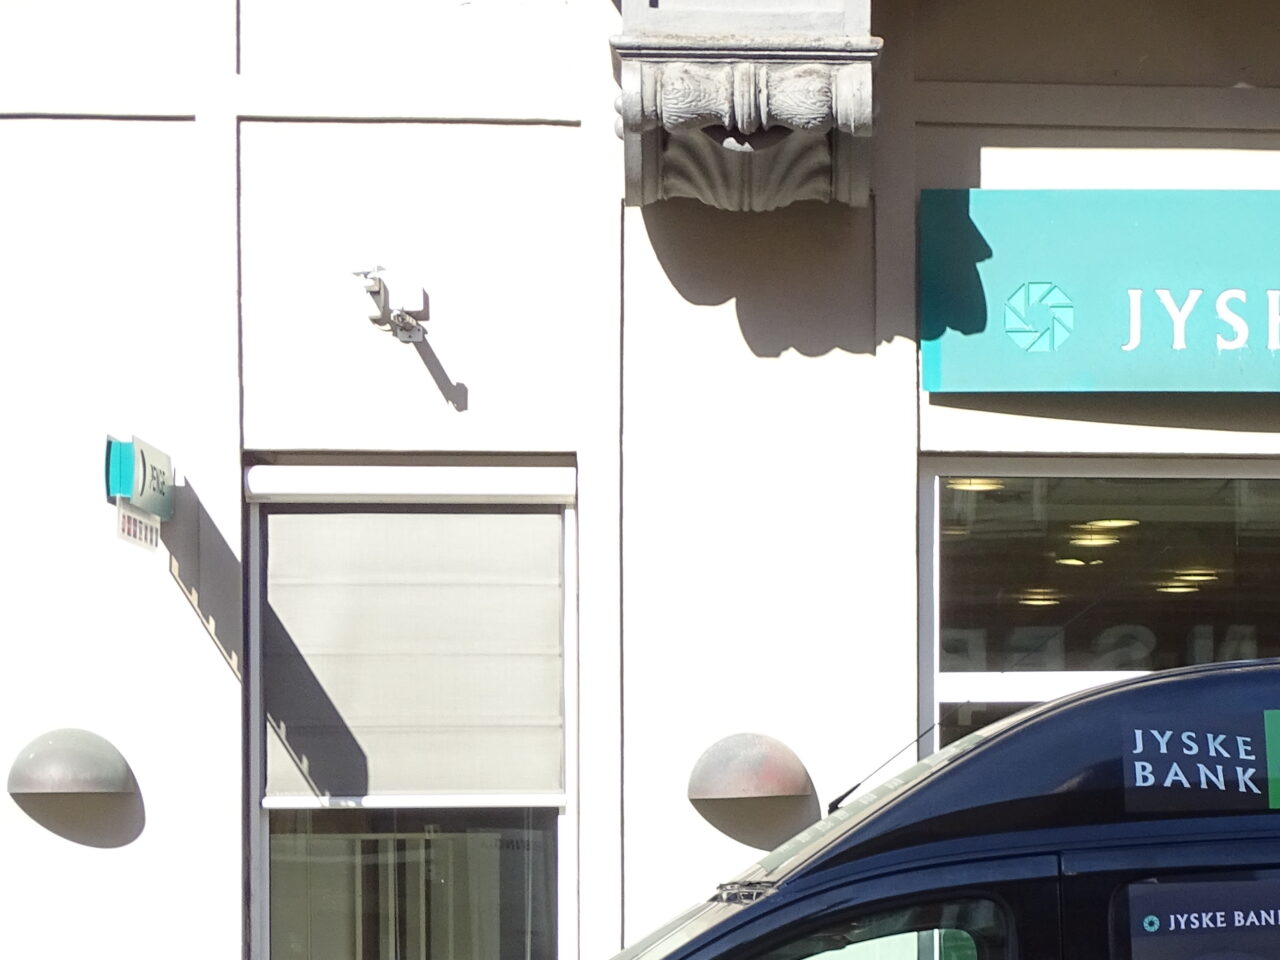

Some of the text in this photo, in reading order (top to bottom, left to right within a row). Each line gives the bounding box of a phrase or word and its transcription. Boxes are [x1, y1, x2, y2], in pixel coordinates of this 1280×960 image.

[1132, 728, 1256, 761] JYSKE
[1134, 761, 1262, 794] BANK
[1169, 911, 1227, 931] JYSKE
